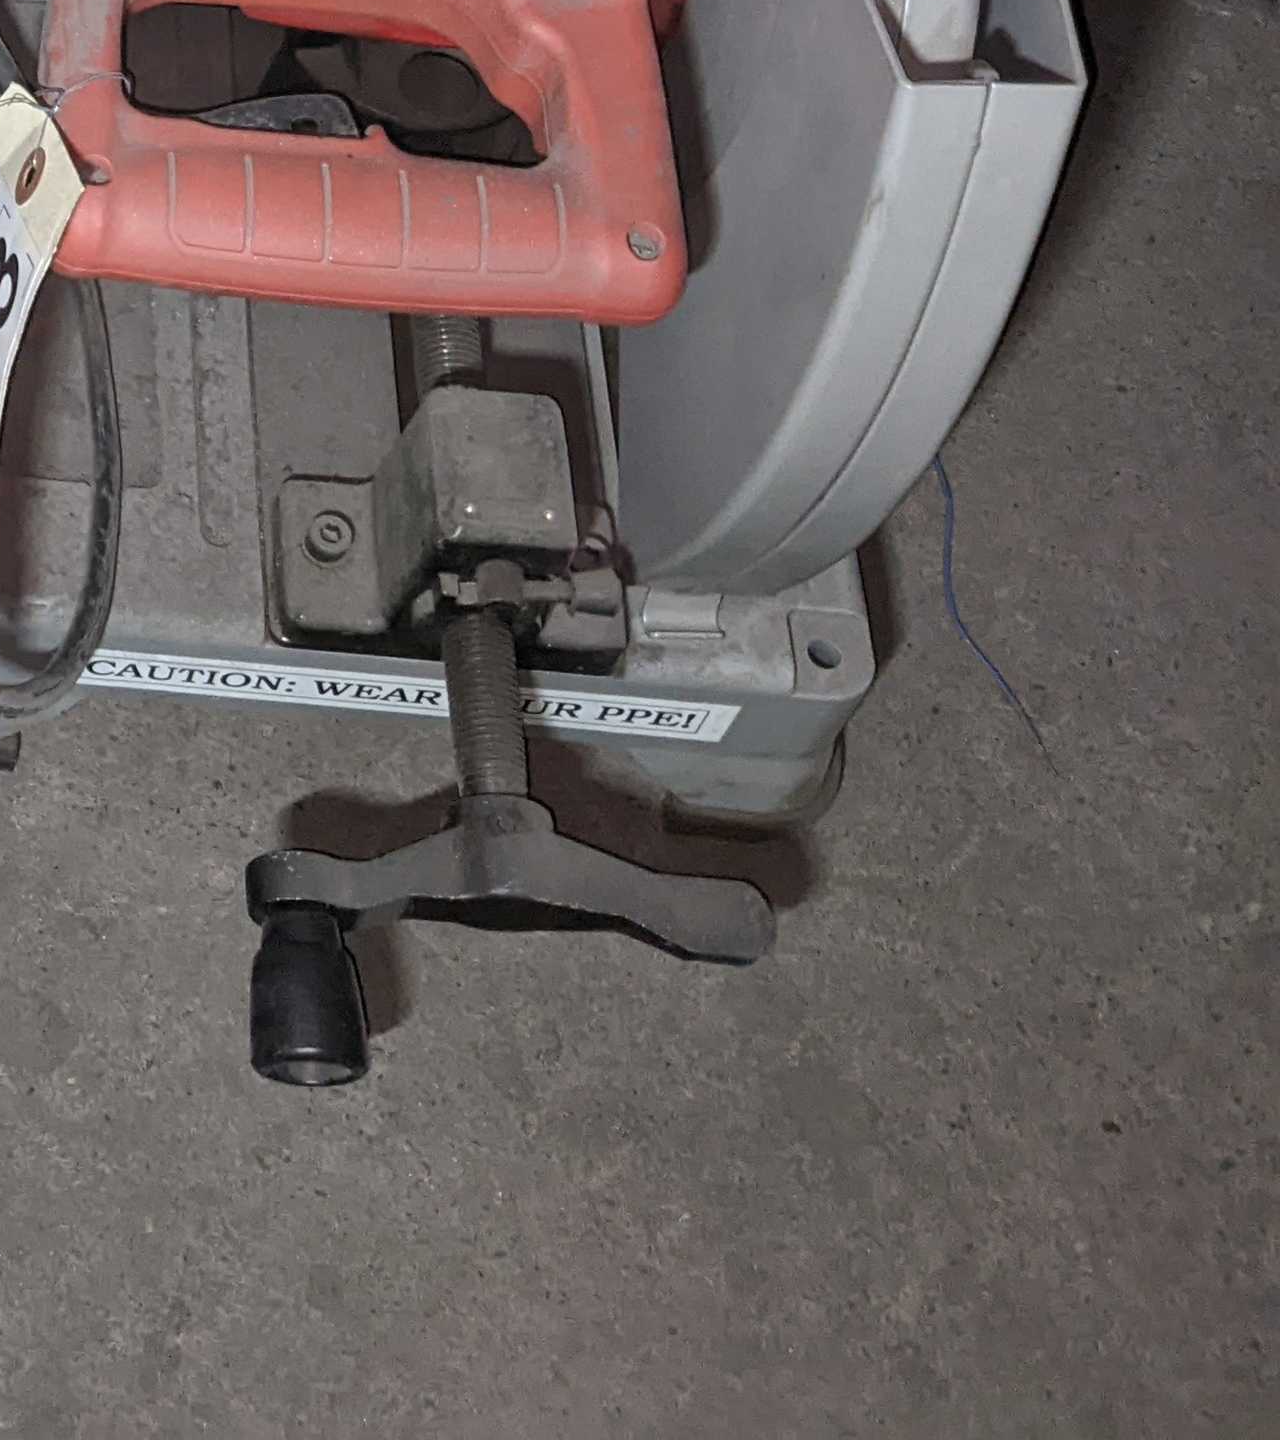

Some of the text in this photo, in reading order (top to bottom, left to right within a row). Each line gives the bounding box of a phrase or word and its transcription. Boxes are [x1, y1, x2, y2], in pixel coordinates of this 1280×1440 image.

[85, 658, 297, 694] CAUTION:
[314, 679, 442, 706] WEAR
[595, 704, 696, 730] PPE!
